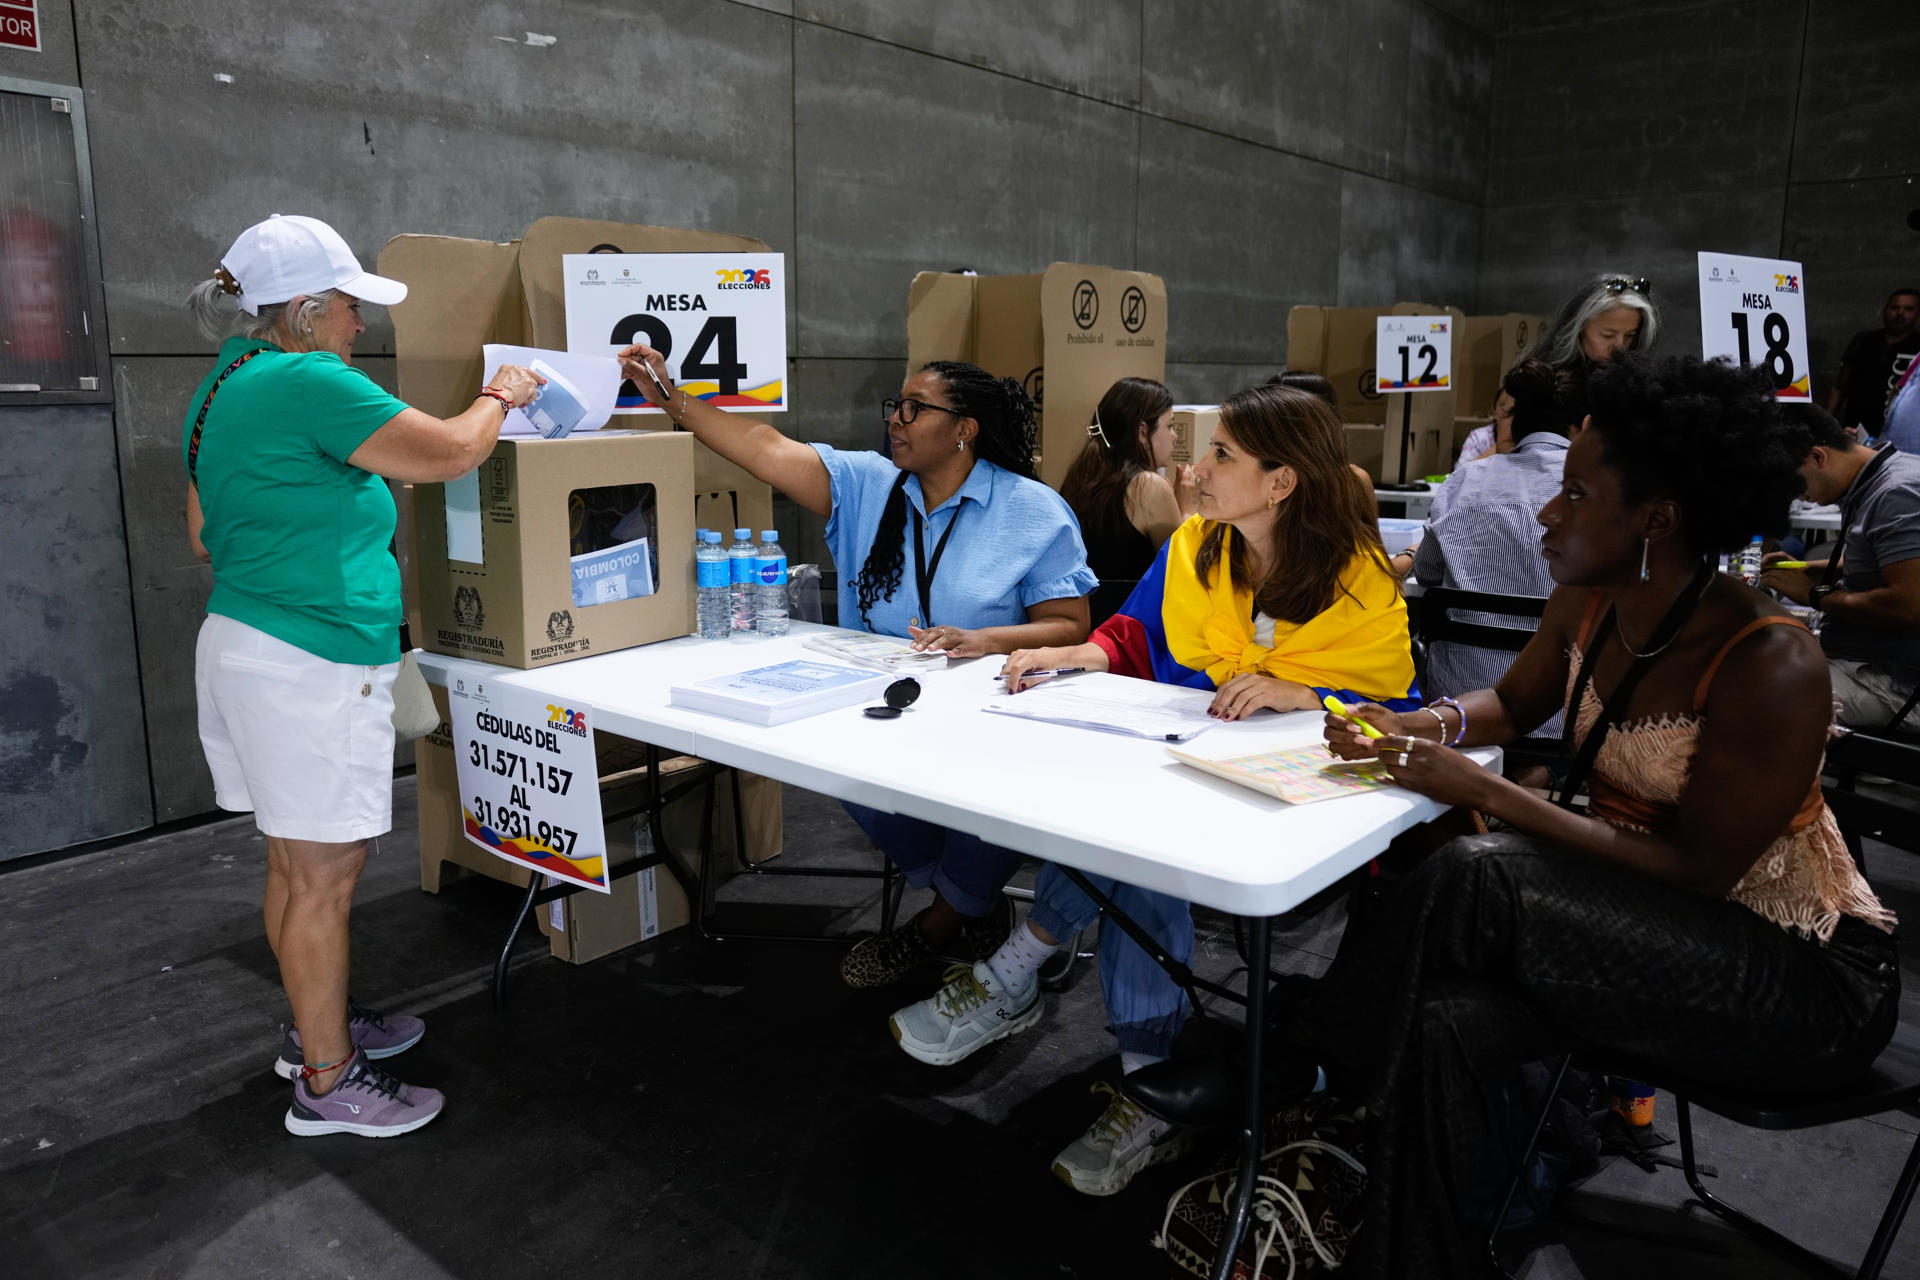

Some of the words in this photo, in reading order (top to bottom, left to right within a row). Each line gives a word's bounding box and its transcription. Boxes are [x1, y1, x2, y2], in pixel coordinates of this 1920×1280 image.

[715, 269, 771, 285] 2026
[1775, 285, 1799, 294] ELECCIONES
[645, 294, 708, 311] MESA
[1742, 293, 1773, 310] MESA
[1067, 333, 1096, 344] Prohibido
[1406, 335, 1427, 343] MESA
[1731, 311, 1795, 390] 18
[609, 313, 748, 397] 24
[1398, 344, 1438, 384] 12
[574, 552, 640, 580] COLOMBIA
[438, 629, 505, 650] REGISTRADURÍA
[476, 708, 533, 745] CÉDULAS
[535, 729, 561, 754] DEL
[546, 704, 587, 733] 2026
[547, 720, 587, 738] ELECCIONES
[470, 740, 573, 796] 31.571.157
[510, 784, 531, 811] AL
[474, 796, 578, 856] 31.931.957
